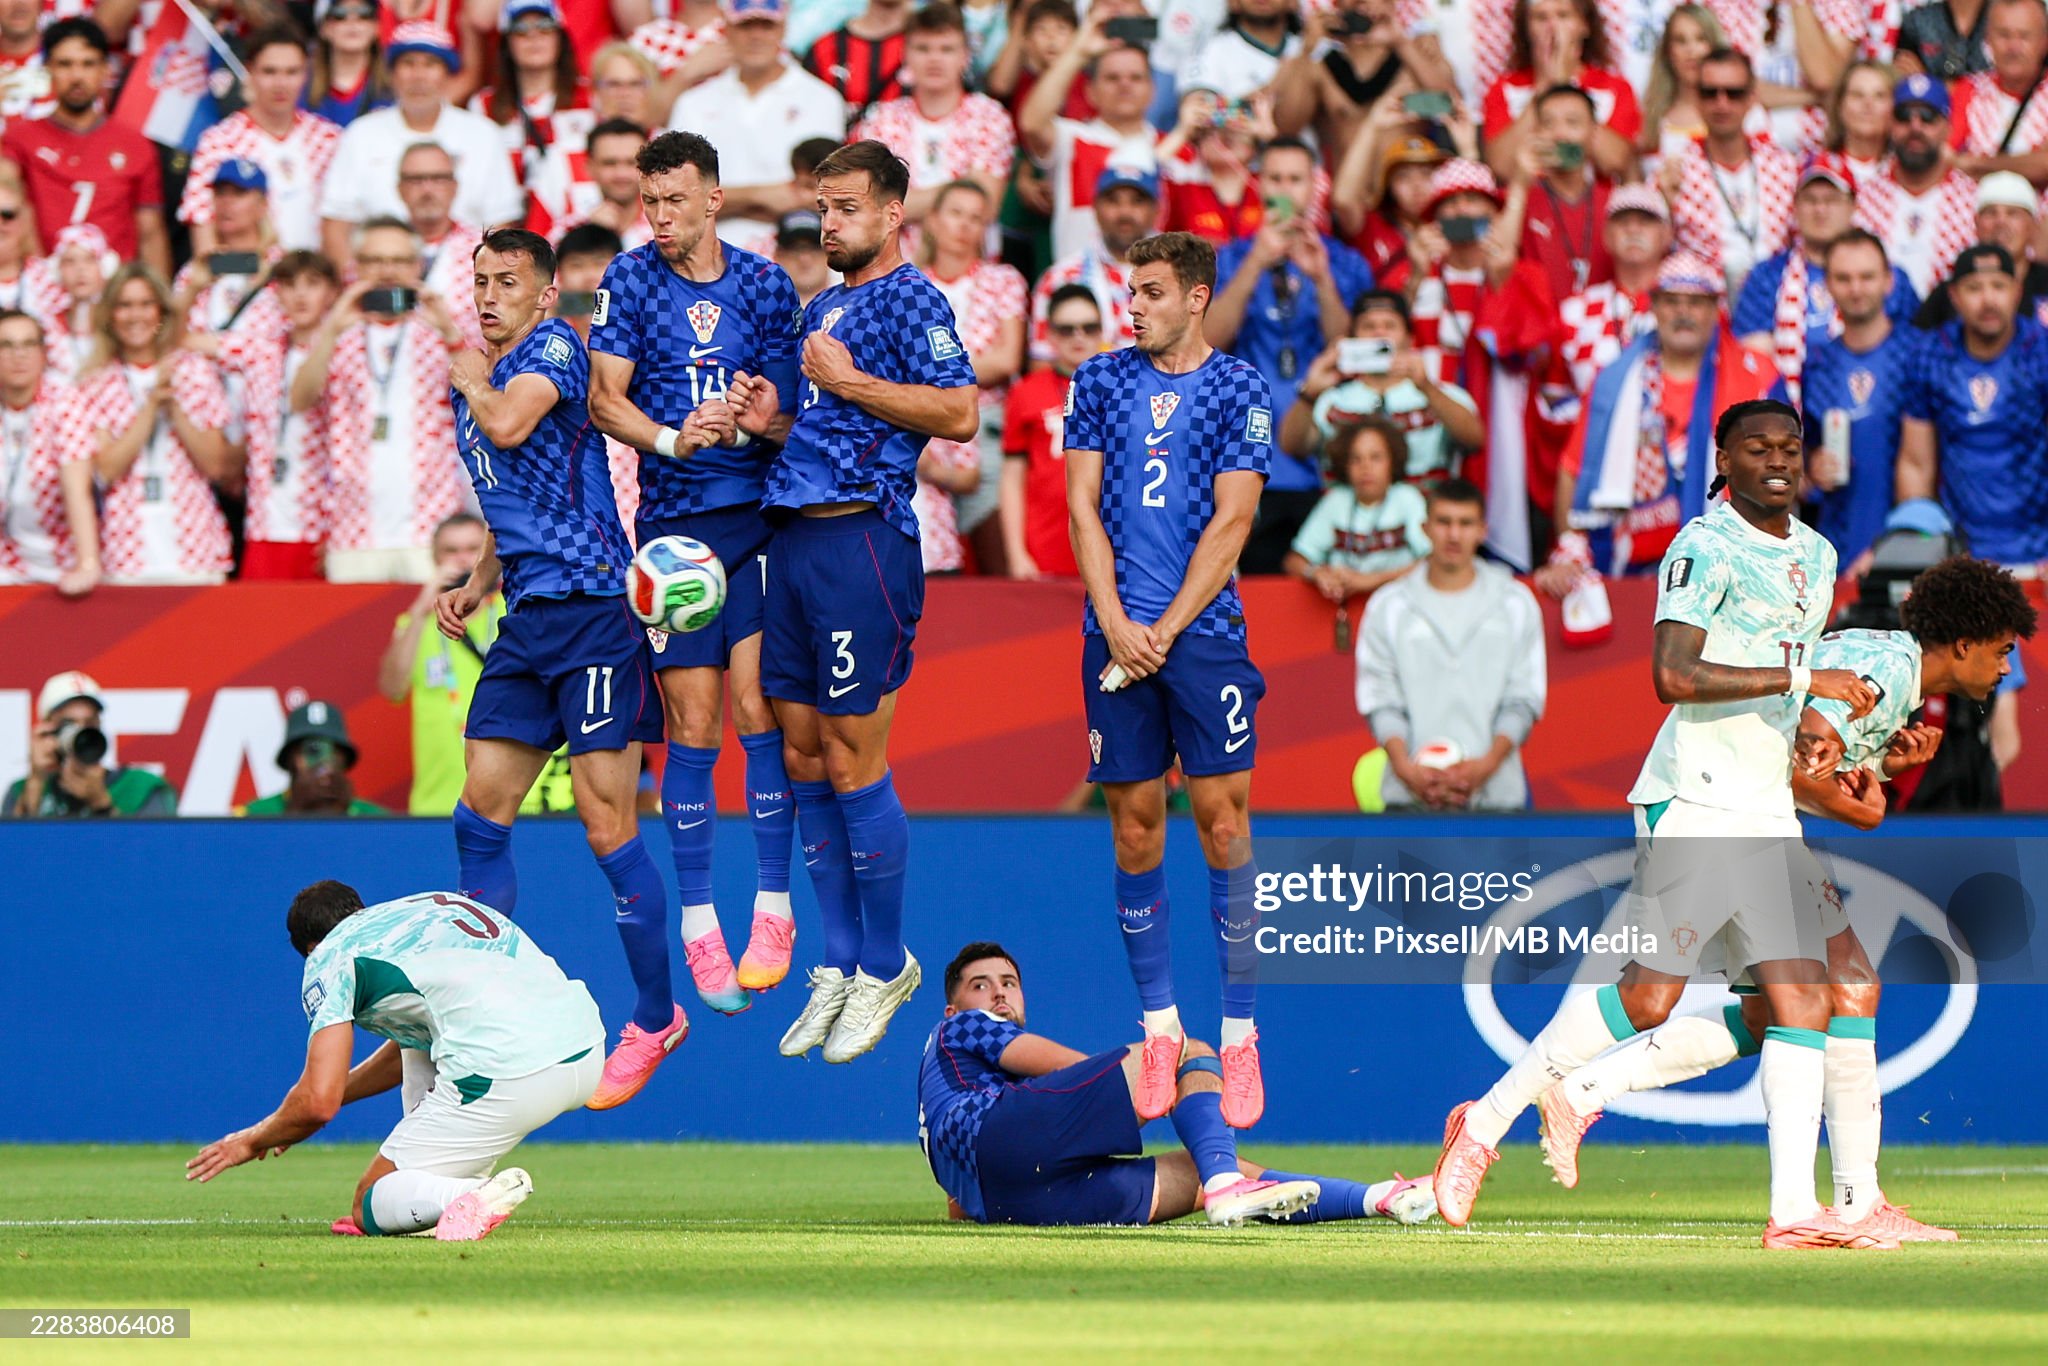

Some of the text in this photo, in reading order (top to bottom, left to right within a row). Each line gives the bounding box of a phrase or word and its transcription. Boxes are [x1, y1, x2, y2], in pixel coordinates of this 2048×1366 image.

[686, 366, 728, 407] 14
[471, 445, 498, 489] 11
[1142, 458, 1168, 508] 2
[757, 555, 767, 596] 1
[831, 630, 855, 679] 3
[586, 667, 613, 714] 11
[1220, 684, 1248, 734] 2
[677, 802, 705, 811] HNS
[756, 791, 782, 800] HNS
[1124, 906, 1151, 918] HNS
